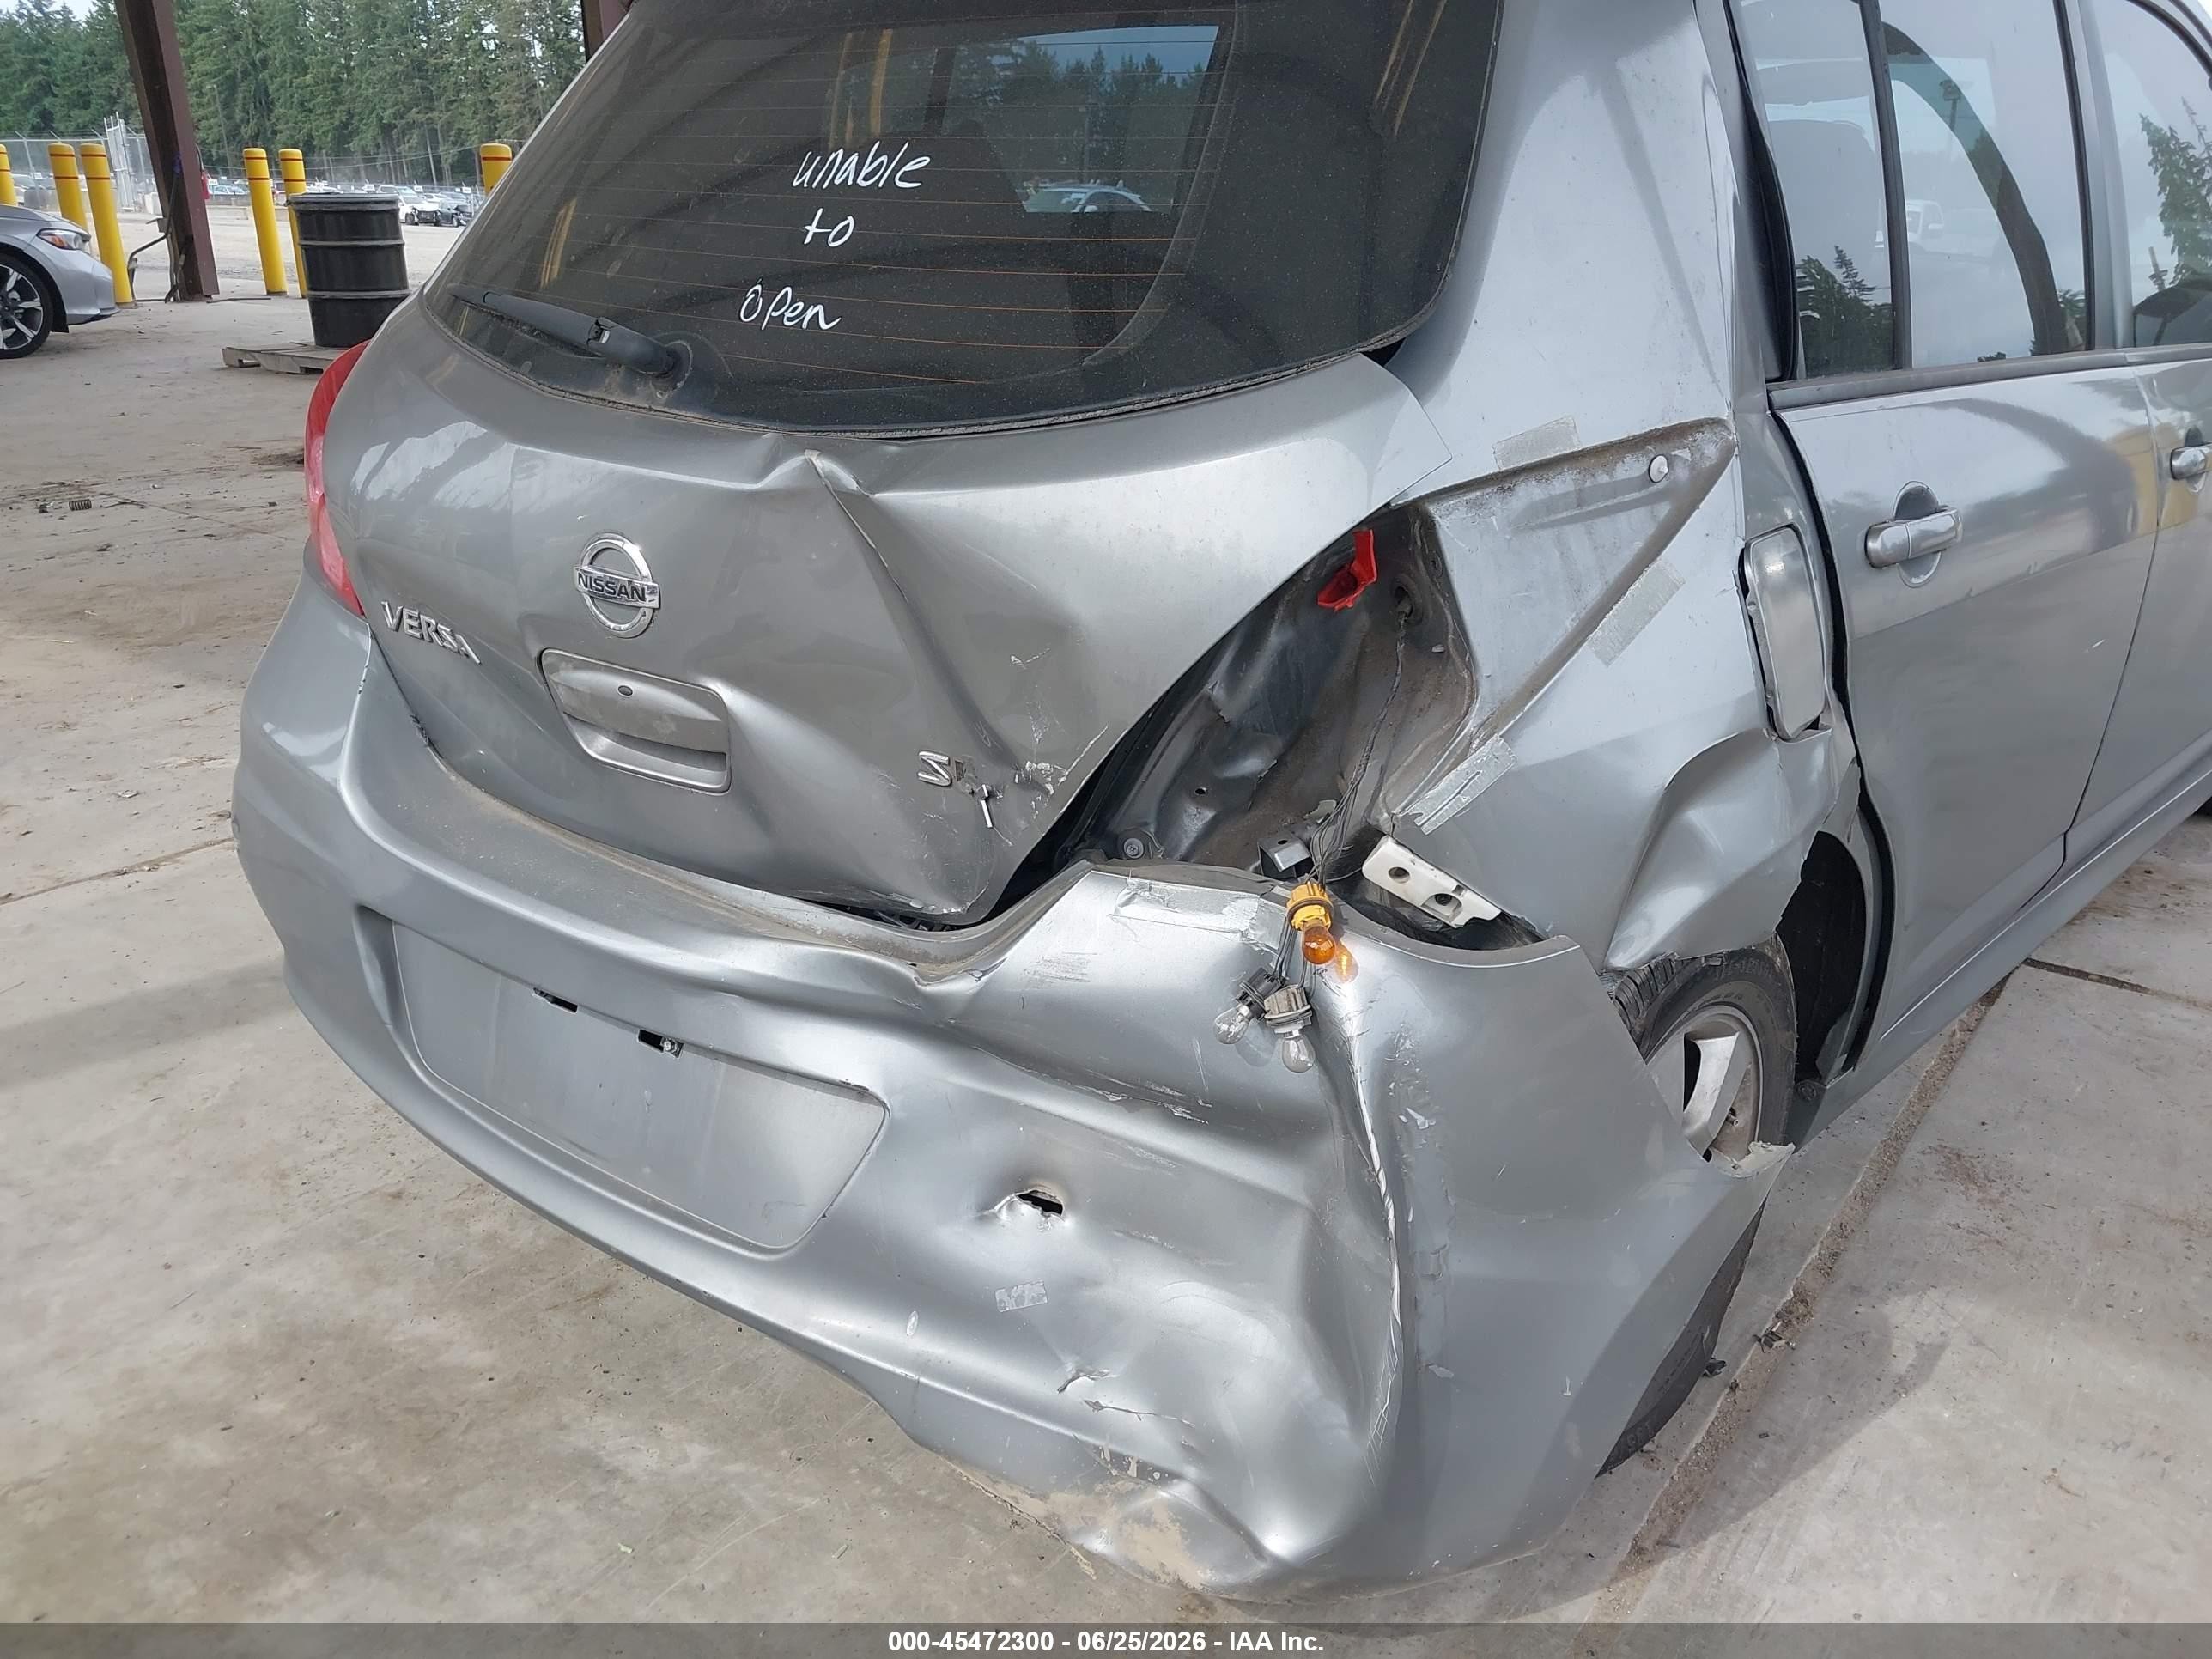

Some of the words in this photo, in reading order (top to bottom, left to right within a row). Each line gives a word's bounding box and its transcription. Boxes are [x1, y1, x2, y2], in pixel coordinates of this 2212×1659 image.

[804, 208, 855, 247] to
[577, 572, 647, 603] NISSAN
[380, 600, 482, 665] VERSA
